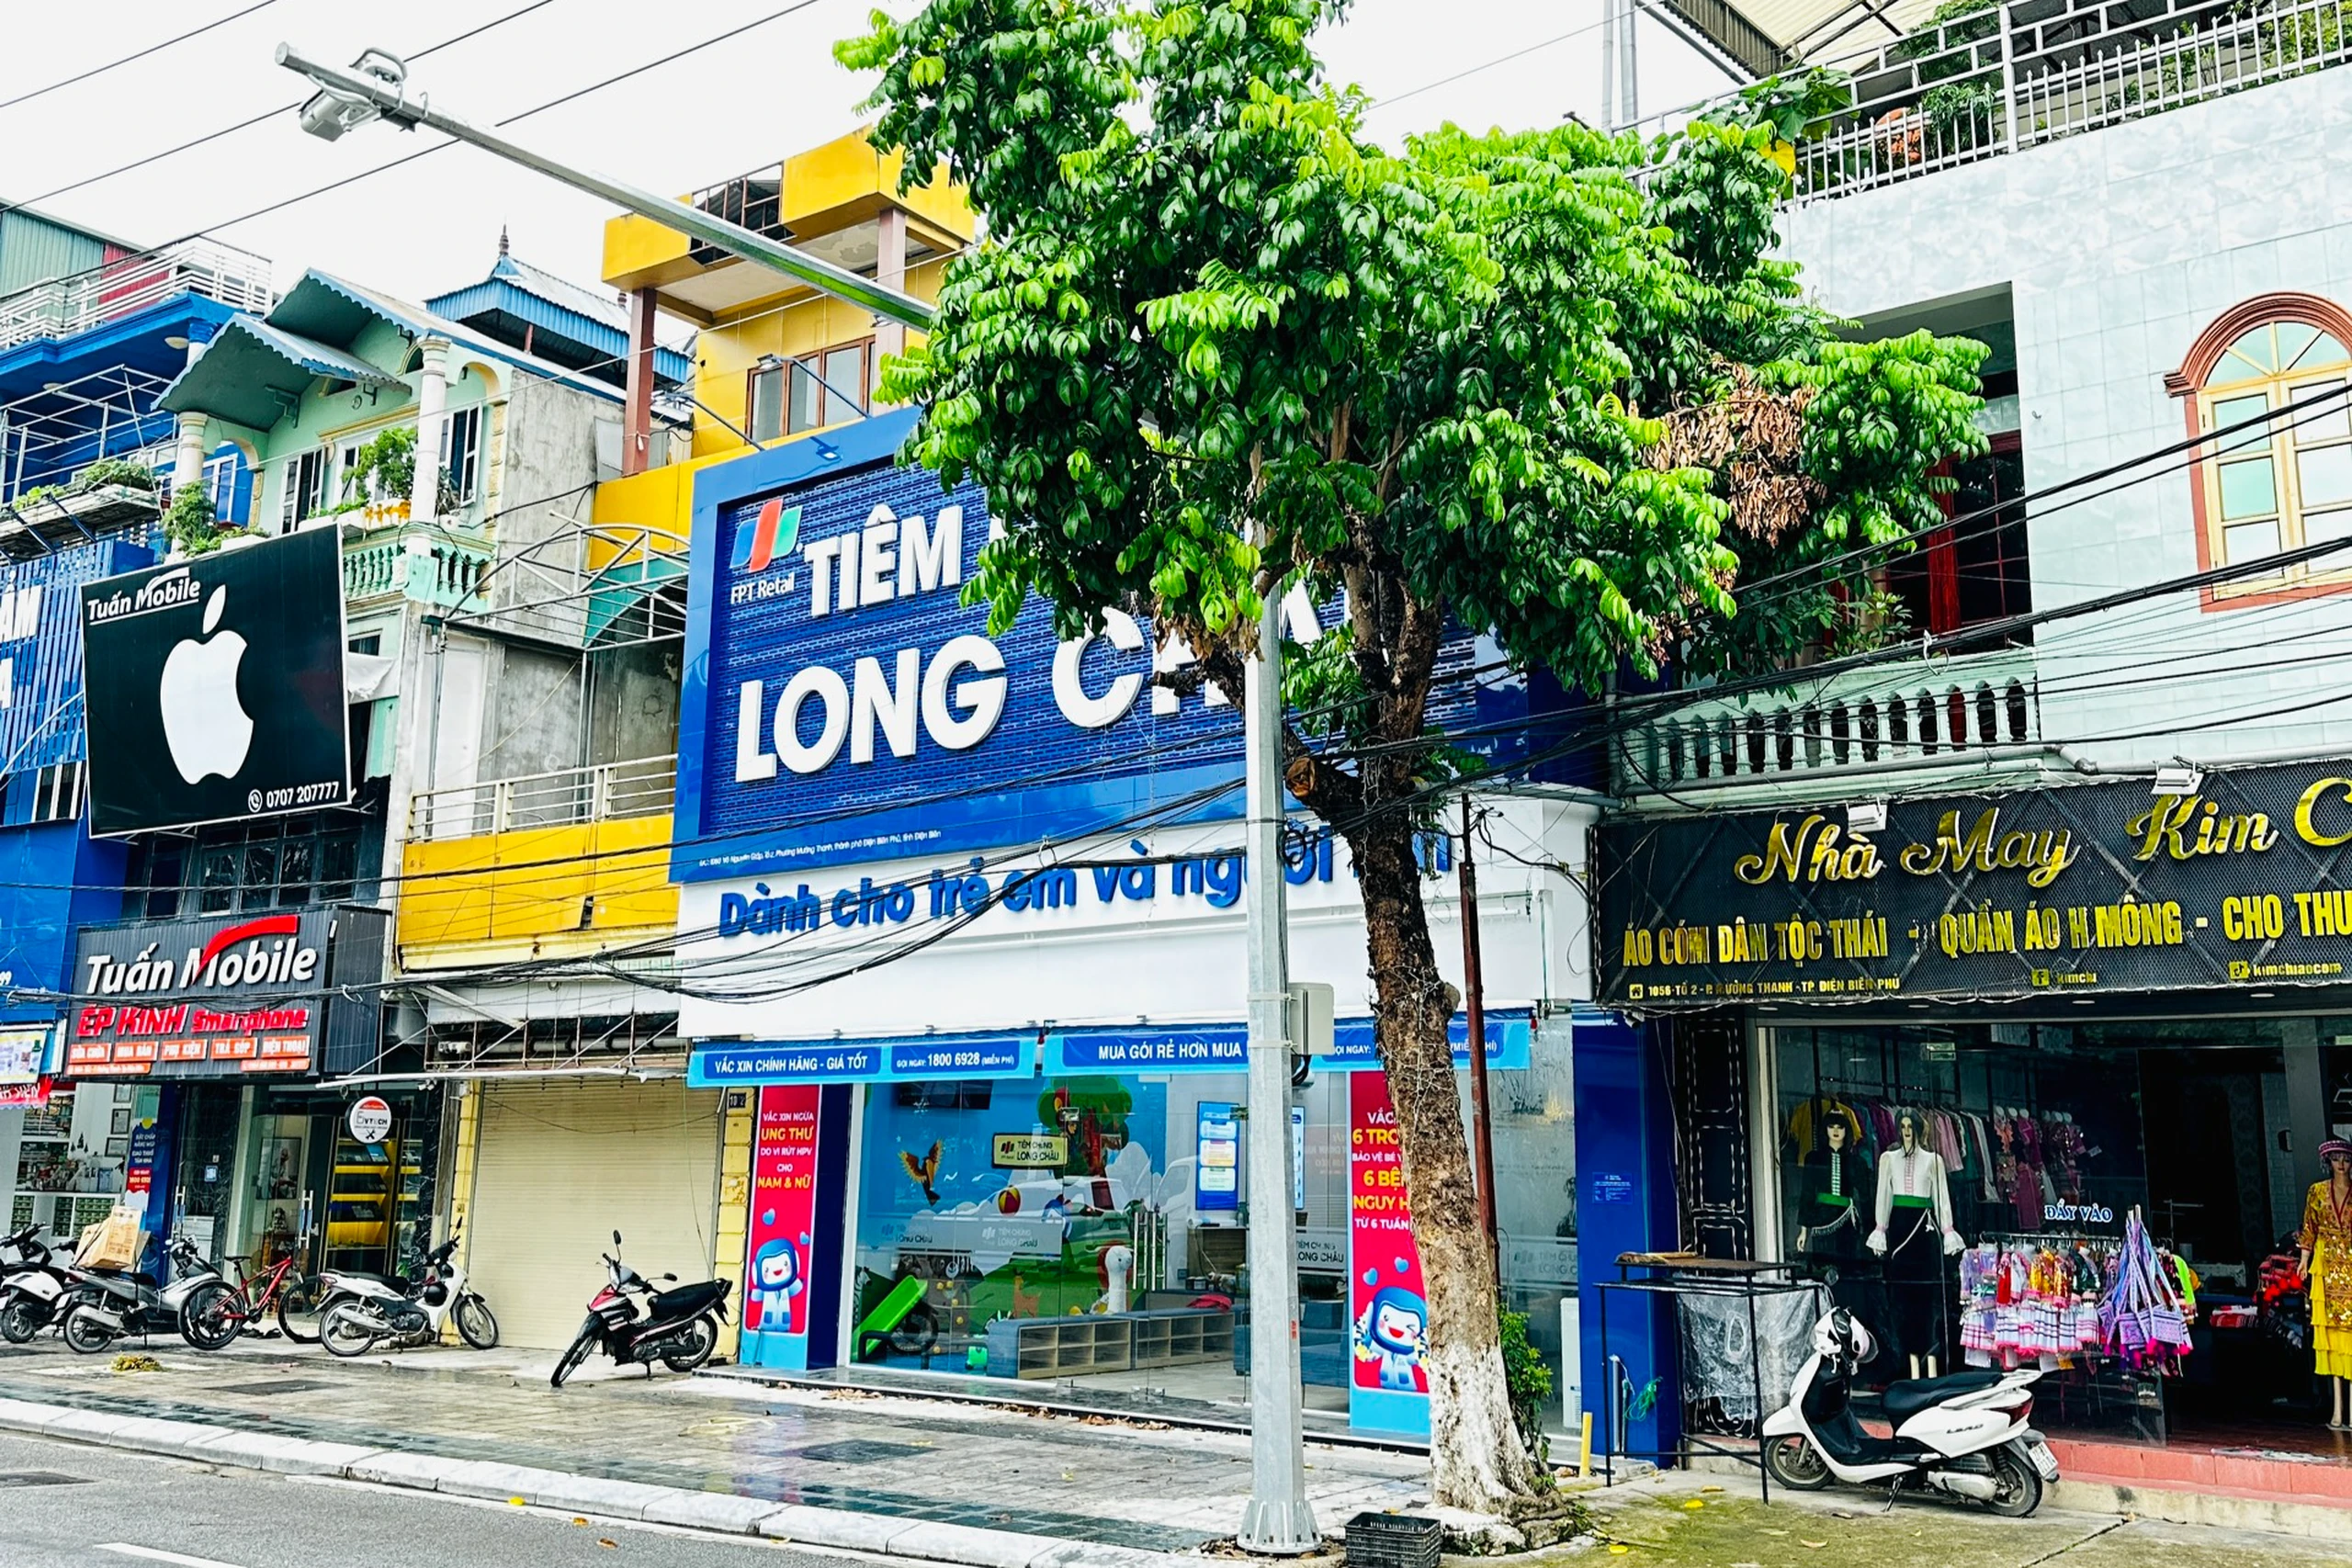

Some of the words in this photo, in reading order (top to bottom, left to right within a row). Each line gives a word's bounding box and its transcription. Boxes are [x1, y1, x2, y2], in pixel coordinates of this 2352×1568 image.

[804, 503, 963, 617] TIÊM
[86, 589, 130, 621] Tuấn
[135, 567, 201, 612] Mobile
[730, 582, 755, 604] FPT
[757, 571, 795, 599] Retail
[735, 634, 1007, 784] LONG
[266, 789, 293, 809] 0707
[297, 781, 339, 805] 207777
[1734, 814, 1885, 885] Nhà
[1901, 806, 2082, 889] May
[2125, 793, 2279, 861] Kim
[719, 882, 821, 938] Dành
[831, 876, 915, 928] cho
[1002, 867, 1076, 913] em
[1092, 840, 1155, 904] và
[1623, 920, 1654, 968] ÁO
[1658, 919, 1711, 965] CÓM
[1717, 916, 1769, 963] DÂN
[1773, 913, 1824, 968] TỘC
[1828, 909, 1889, 960] THÁI
[1939, 898, 2016, 960] QUẦN
[2024, 900, 2061, 951] ÁO
[2222, 893, 2285, 942] CHO
[85, 942, 177, 996] Tuấn
[178, 933, 319, 990] Mobile
[1690, 985, 1698, 996] 2
[1757, 981, 1793, 993] THANH
[1818, 977, 1845, 993] ĐIỆN
[1848, 976, 1873, 991] BIÊN
[1877, 973, 1901, 989] PHỦ
[190, 1006, 311, 1037] Smartphone
[1098, 1045, 1126, 1060] MUA
[1129, 1041, 1153, 1059] GÓI
[1157, 1038, 1175, 1058] RẺ
[1179, 1043, 1208, 1058] HƠN
[1212, 1042, 1242, 1057] MUA
[1348, 1045, 1372, 1055] NGAY:
[1449, 1040, 1470, 1053] (MIỄ
[715, 1055, 735, 1074] VẮC
[736, 1059, 752, 1073] XIN
[755, 1056, 786, 1073] CHÍNH
[788, 1055, 818, 1071] HÃNG
[826, 1054, 844, 1070] GIÁ
[847, 1050, 868, 1069] TỐT
[927, 1054, 952, 1066] 1800
[955, 1052, 980, 1066] 6928
[761, 1128, 786, 1141] UNG
[788, 1125, 814, 1140] THƯ
[1352, 1128, 1363, 1145] 6
[1365, 1128, 1399, 1145] TRO
[774, 1147, 781, 1156] VI
[782, 1145, 796, 1156] RÚT
[797, 1147, 812, 1156] HPV
[1017, 1151, 1038, 1161] LONG
[1351, 1151, 1371, 1162] BẢO
[776, 1163, 794, 1173] CHO
[1363, 1170, 1375, 1187] 6
[1378, 1166, 1407, 1191] BỆ
[757, 1177, 782, 1189] NAM
[784, 1177, 792, 1189] &
[1353, 1195, 1396, 1211] NGUY
[1354, 1216, 1369, 1228] TỪ
[1371, 1218, 1378, 1229] 6
[1296, 1250, 1318, 1262] ONG
[1320, 1250, 1345, 1263] CHÂU
